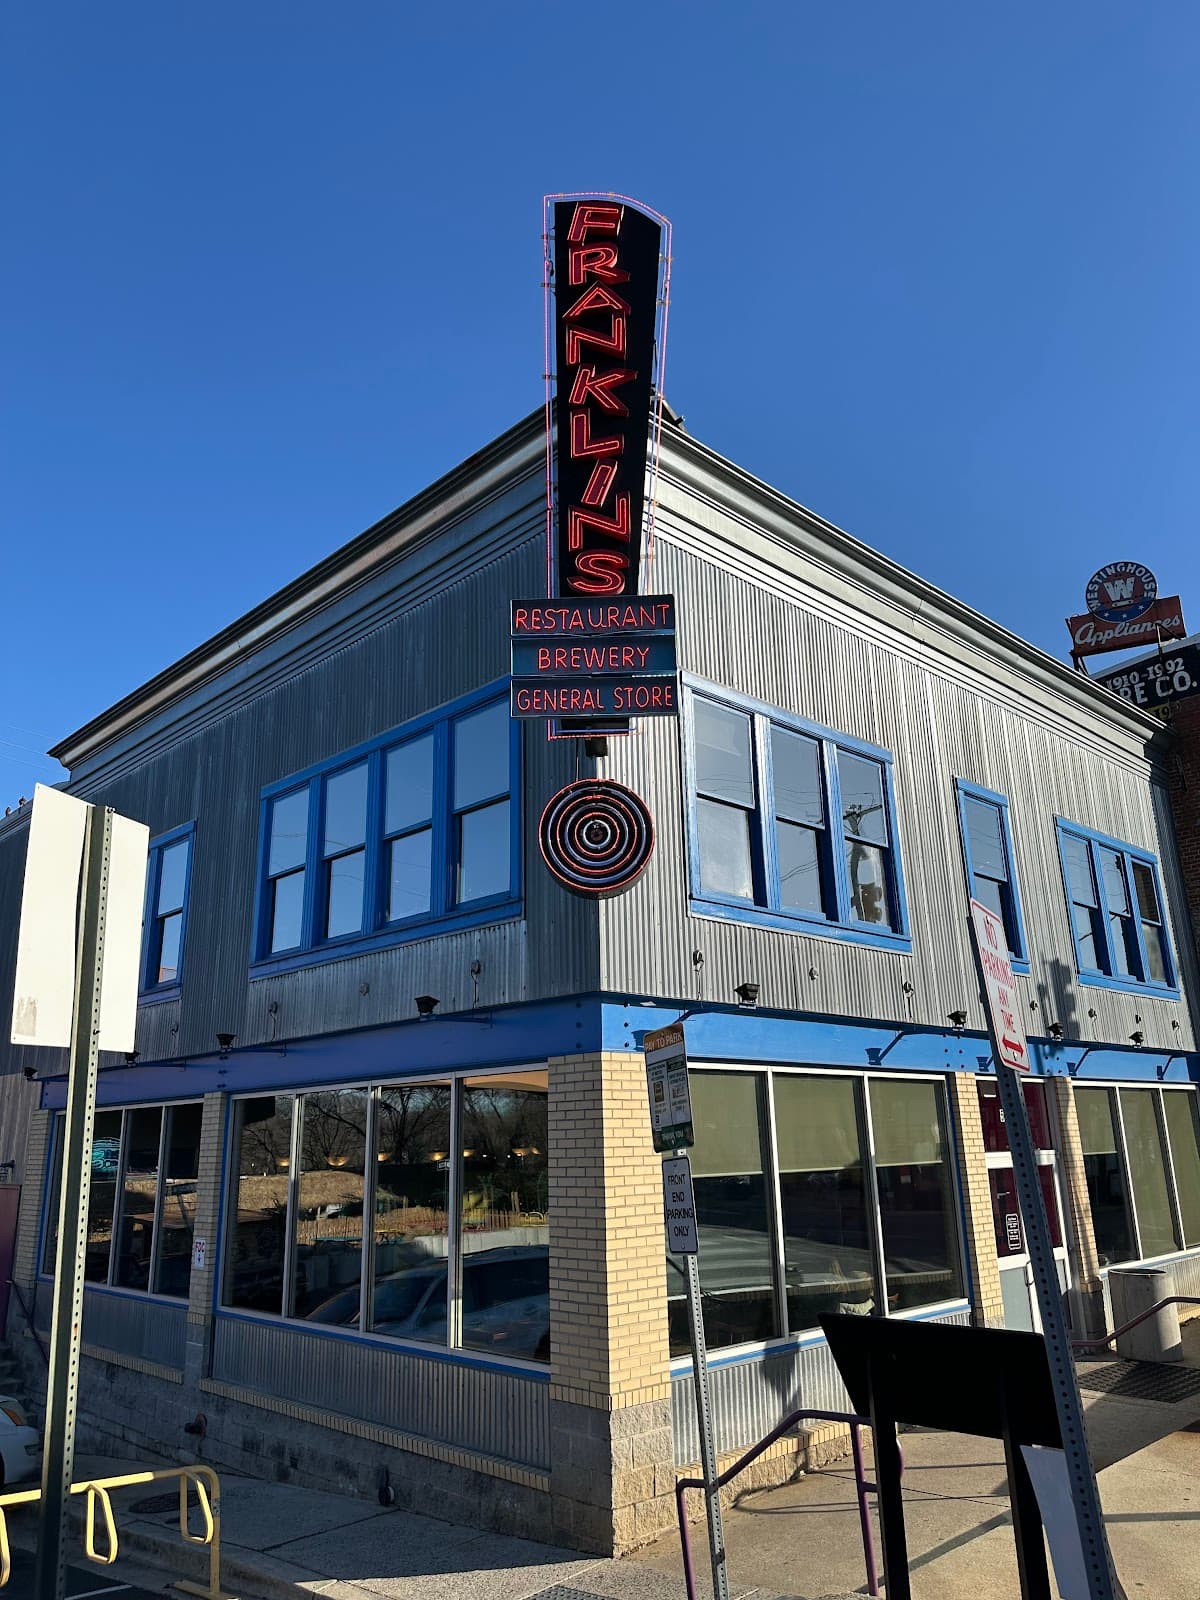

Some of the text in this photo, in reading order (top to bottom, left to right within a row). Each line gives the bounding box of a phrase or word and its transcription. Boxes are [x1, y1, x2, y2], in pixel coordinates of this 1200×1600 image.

[562, 201, 638, 595] FRANKLINS
[1086, 563, 1156, 612] WESTINGHOUSE
[1103, 577, 1136, 601] W
[514, 604, 670, 630] RESTAURANT
[537, 646, 650, 670] BREWERY
[1155, 670, 1198, 698] CO.
[516, 685, 673, 711] GENERAL STORE
[983, 915, 998, 950] NO
[980, 947, 1015, 989] PARKING
[1001, 1009, 1016, 1033] TIME
[656, 1038, 665, 1048] TO
[666, 1031, 683, 1046] PARK
[667, 1174, 686, 1186] FRONT
[672, 1192, 685, 1203] END
[667, 1208, 694, 1220] PARKING
[673, 1225, 690, 1237] ONLY
